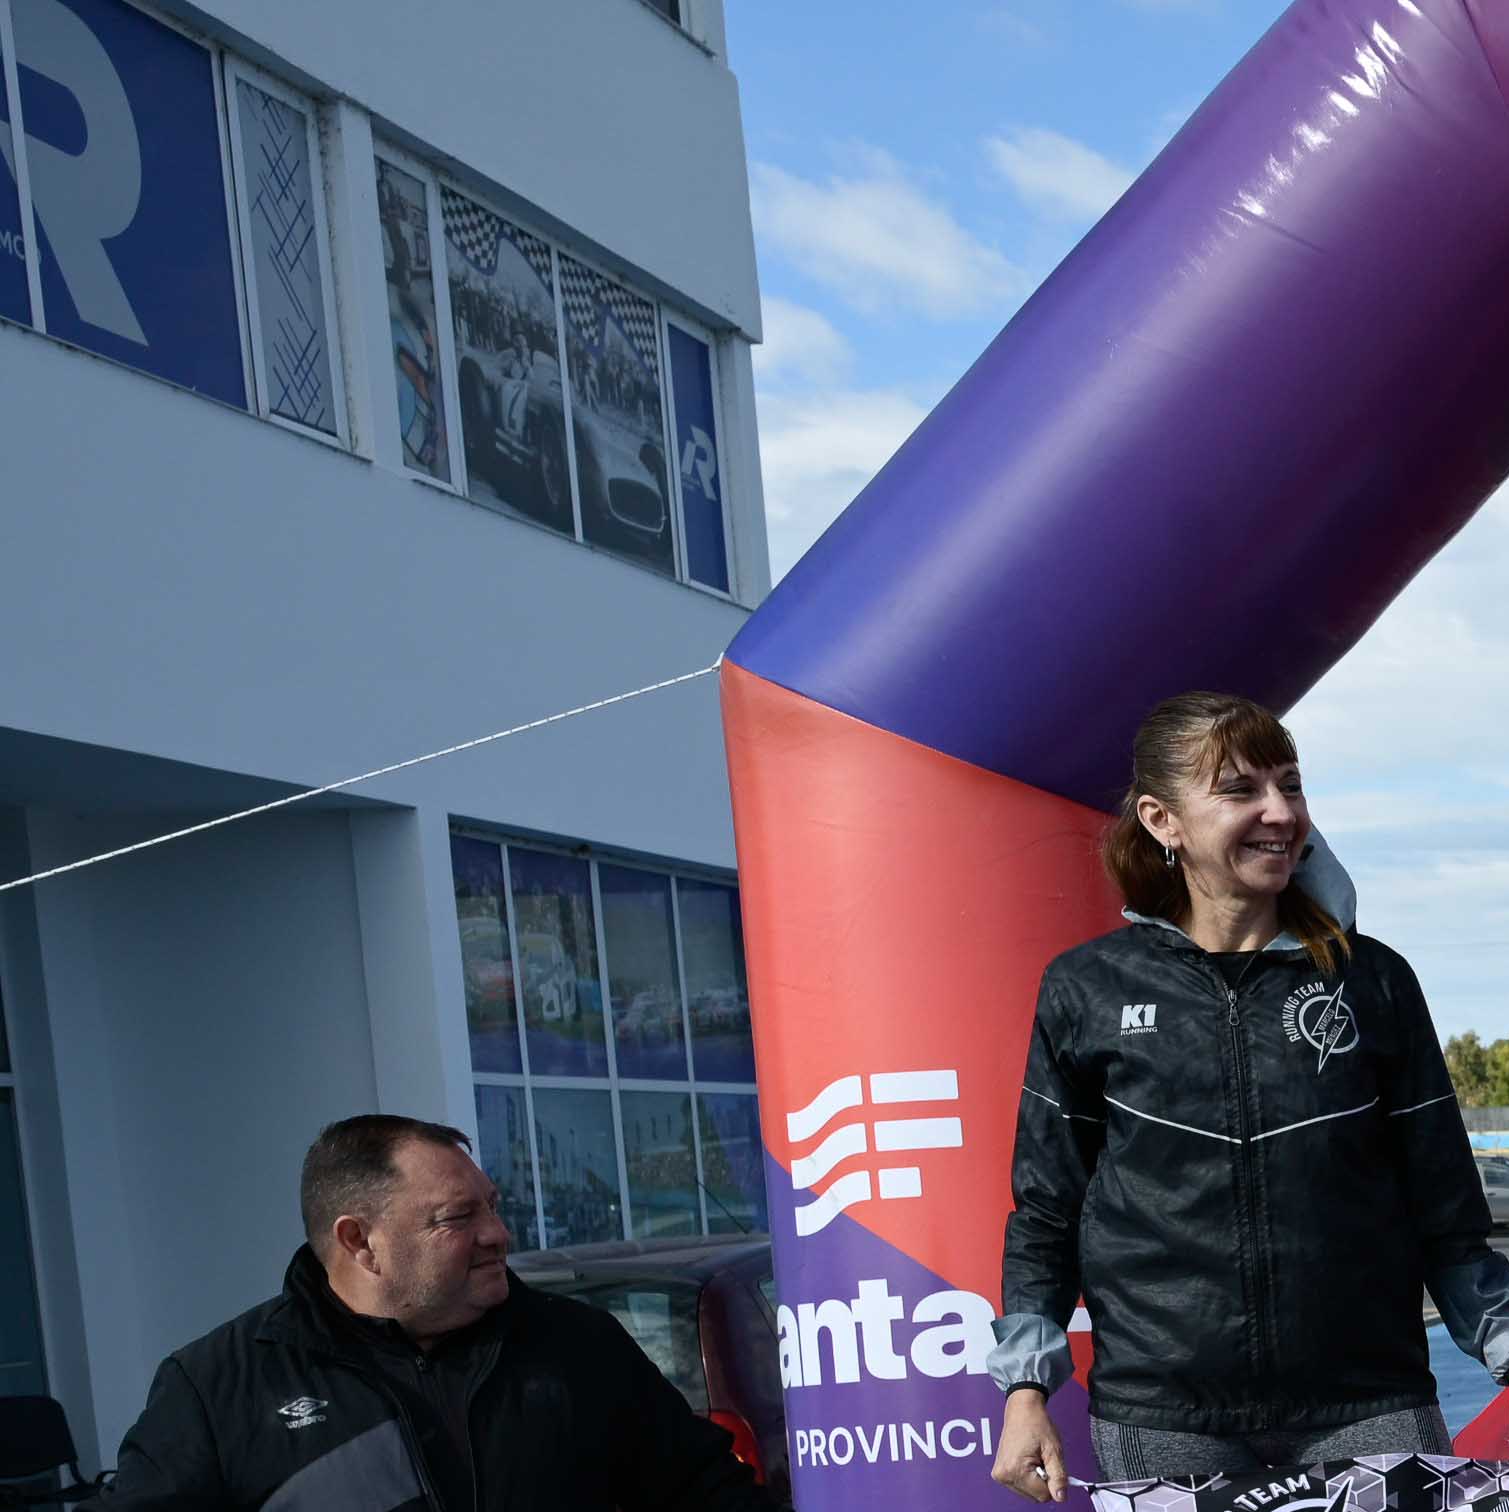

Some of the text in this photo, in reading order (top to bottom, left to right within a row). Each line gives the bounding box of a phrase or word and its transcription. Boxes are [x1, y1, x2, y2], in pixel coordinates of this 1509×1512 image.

[1121, 1003, 1157, 1029] K1
[1281, 981, 1325, 1043] RUNNING TEAM
[1233, 1473, 1311, 1512] TEAM
